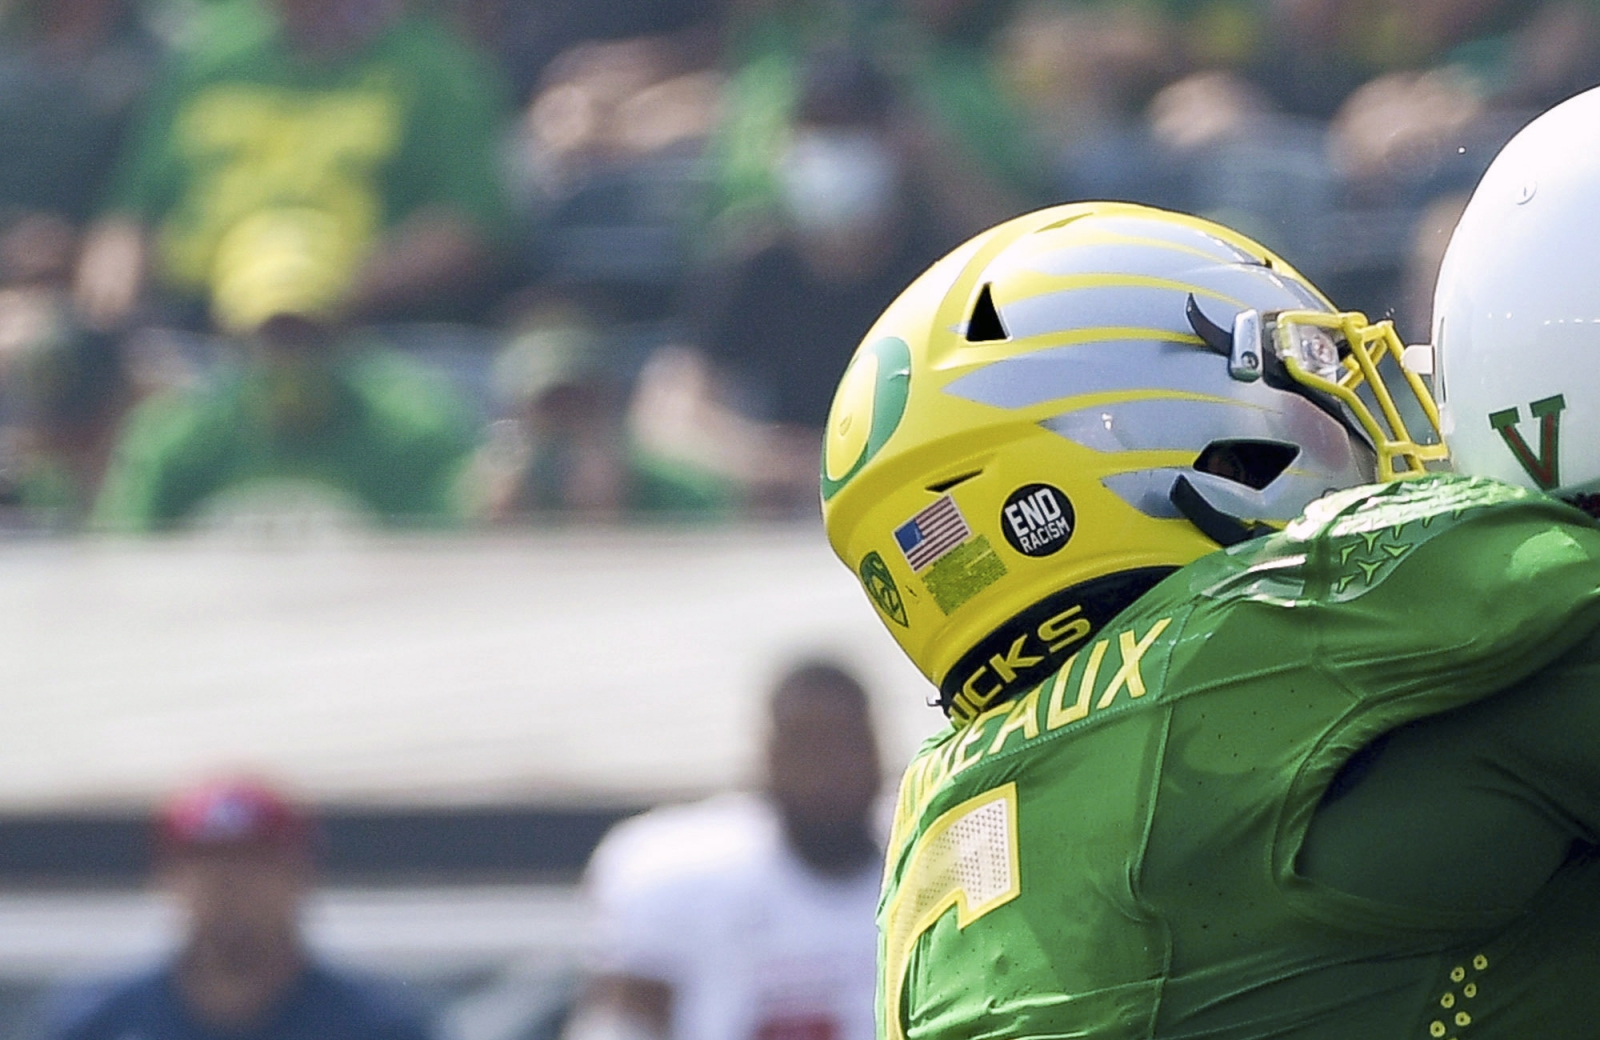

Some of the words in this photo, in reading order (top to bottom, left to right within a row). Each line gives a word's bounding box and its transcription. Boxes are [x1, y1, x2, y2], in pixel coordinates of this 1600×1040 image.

[1488, 394, 1566, 493] V
[1004, 487, 1062, 538] END
[1019, 516, 1071, 554] RACISM
[947, 604, 1091, 730] UCKS
